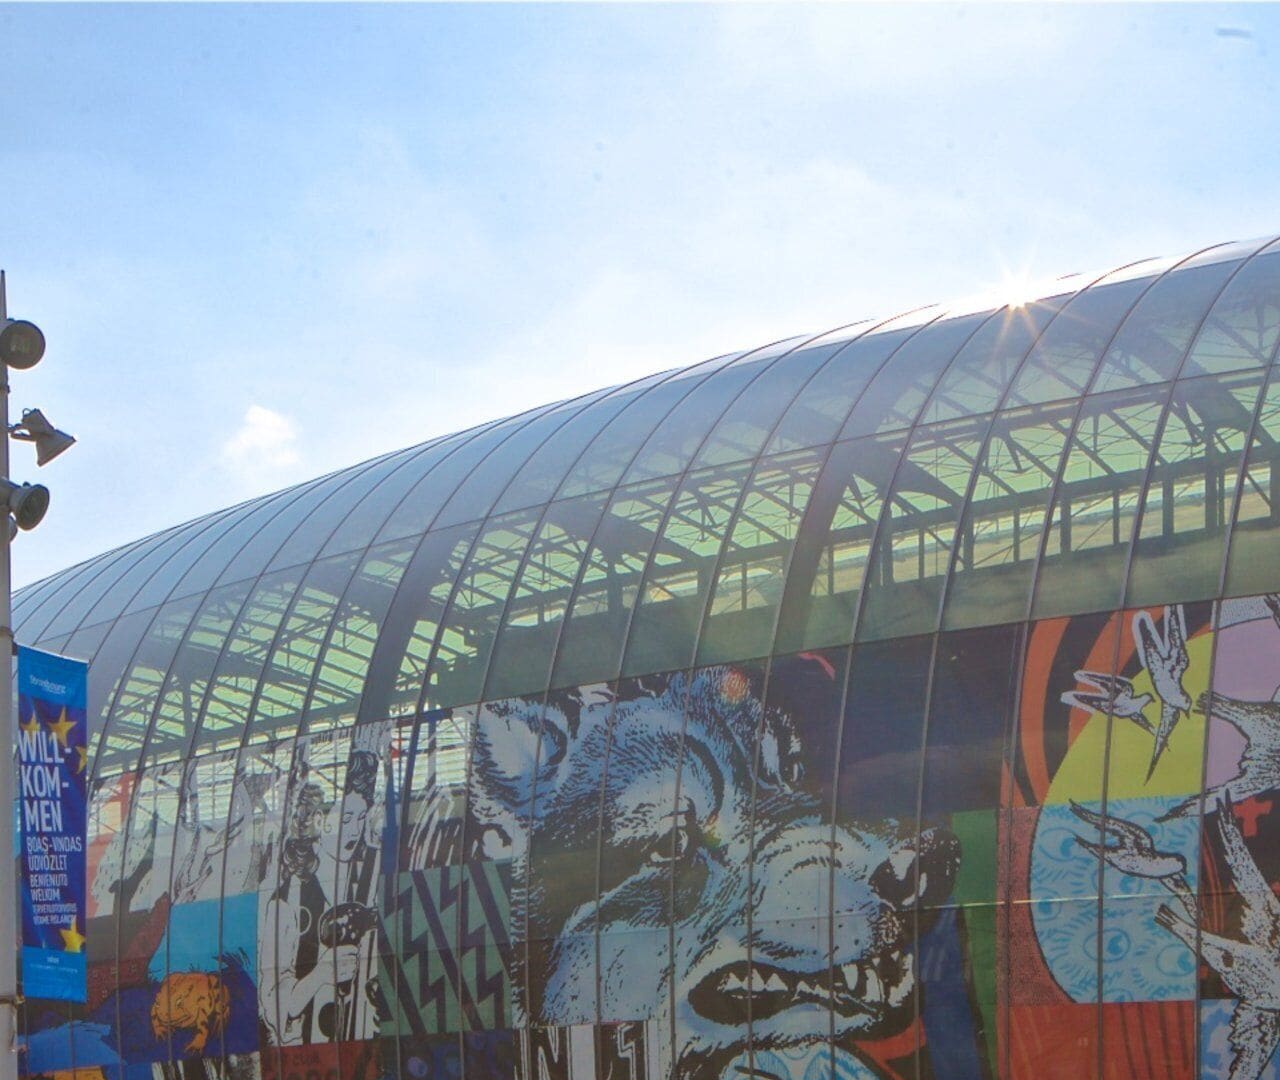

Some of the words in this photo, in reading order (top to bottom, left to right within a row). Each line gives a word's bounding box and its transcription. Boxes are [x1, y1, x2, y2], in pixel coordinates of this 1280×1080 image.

[19, 731, 72, 764] WILL-
[21, 765, 70, 798] KOM-
[24, 801, 63, 832] MEN
